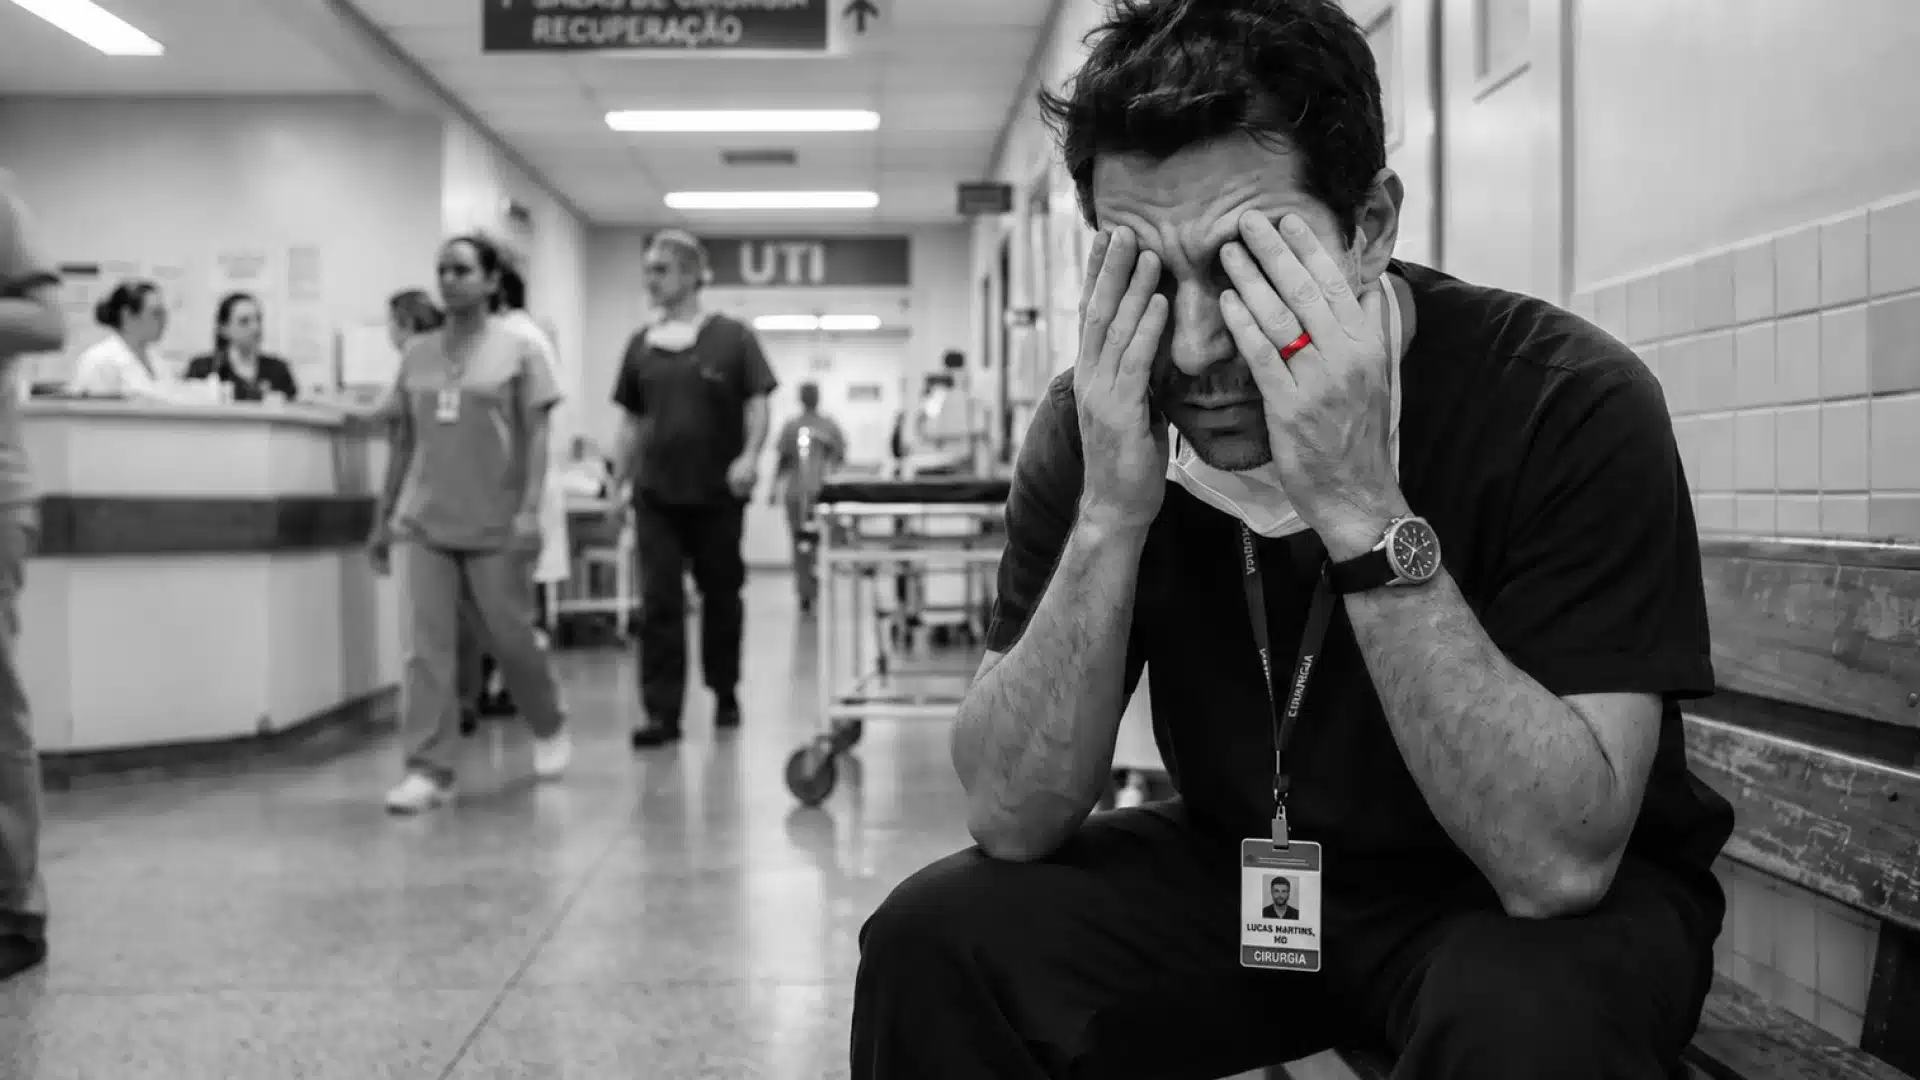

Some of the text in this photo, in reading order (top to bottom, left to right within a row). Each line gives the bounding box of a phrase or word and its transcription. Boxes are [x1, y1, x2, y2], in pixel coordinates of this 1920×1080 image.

[532, 13, 743, 49] RECUPERAÇÃO
[740, 243, 825, 283] UTI
[1246, 923, 1273, 933] LUCAS
[1253, 950, 1307, 965] CIRURGIA
